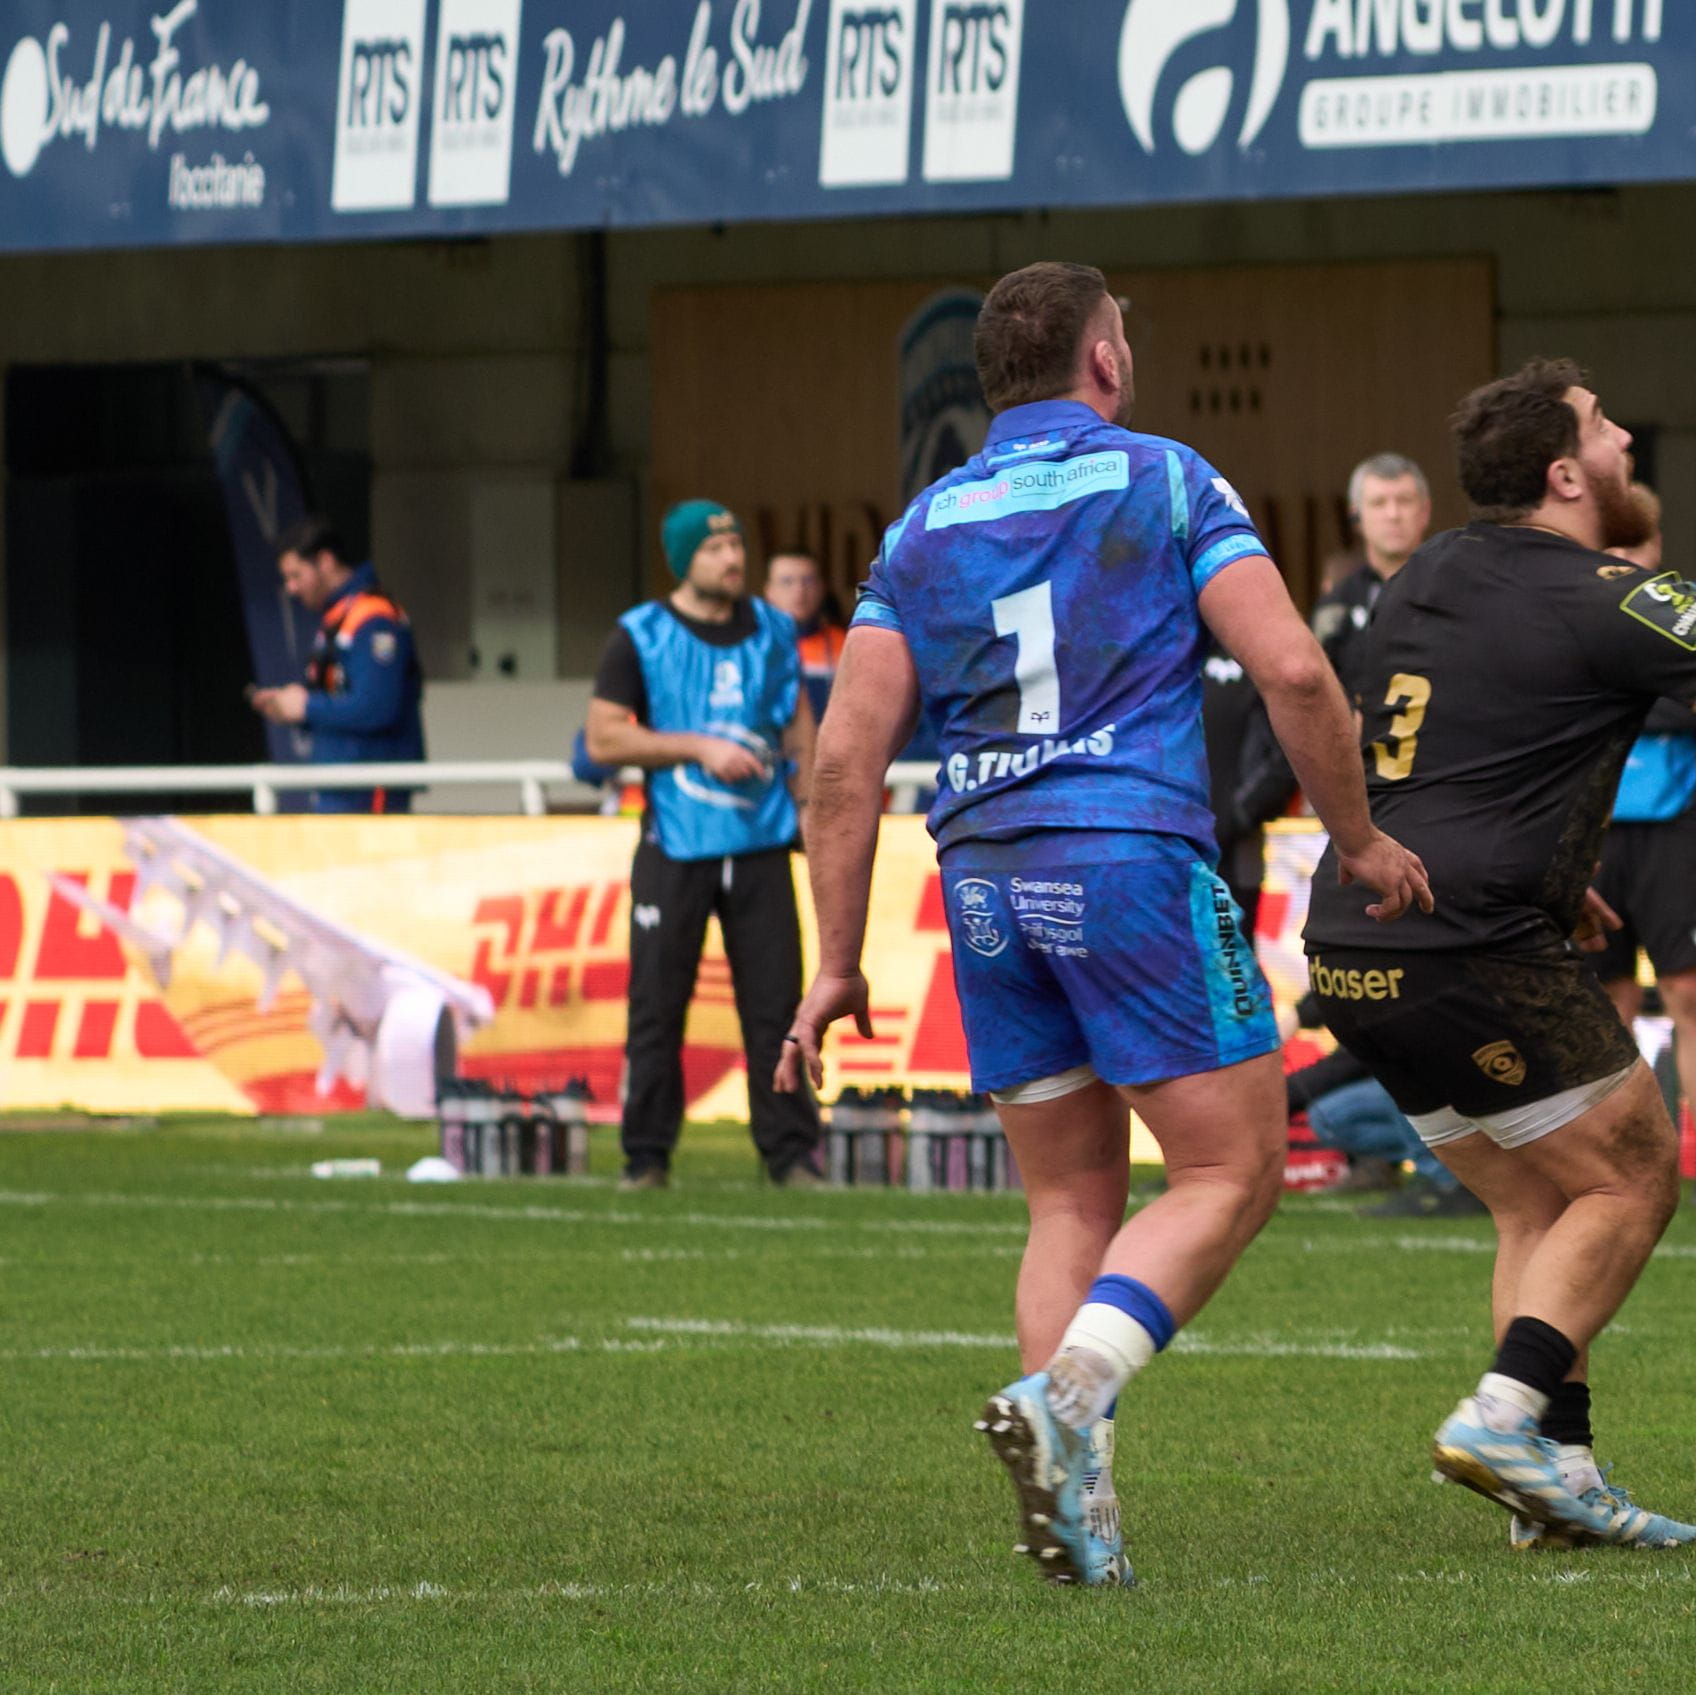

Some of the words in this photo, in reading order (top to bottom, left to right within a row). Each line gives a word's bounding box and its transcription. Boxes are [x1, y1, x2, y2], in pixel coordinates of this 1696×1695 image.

[1312, 89, 1433, 133] GROUPE
[1449, 78, 1646, 125] IMMOBILIER
[1012, 470, 1065, 491] south
[1066, 458, 1118, 482] africa
[990, 580, 1062, 735] 1
[1371, 672, 1433, 781] 3
[1009, 877, 1084, 897] Swansea
[1211, 883, 1252, 1017] QUINNBET
[1309, 955, 1405, 1000] rbaser
